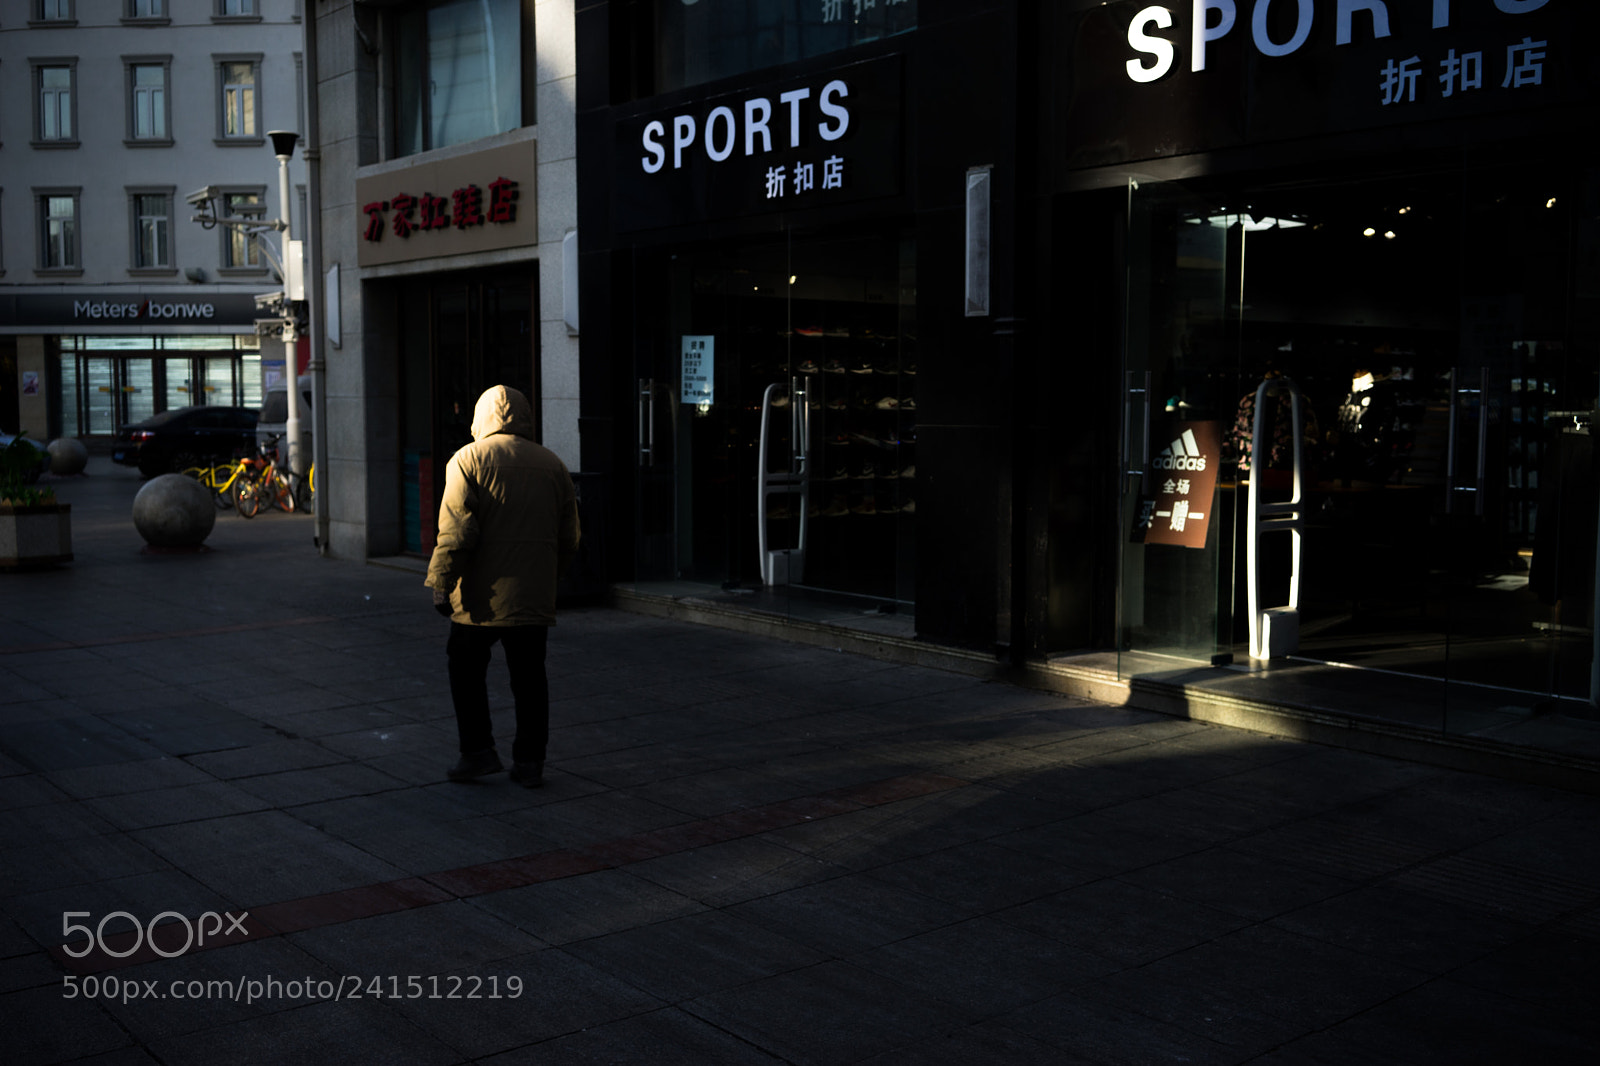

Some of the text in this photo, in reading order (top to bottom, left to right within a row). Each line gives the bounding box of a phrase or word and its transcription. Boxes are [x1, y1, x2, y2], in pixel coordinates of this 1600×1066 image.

[1126, 0, 1549, 84] SPOR
[1379, 38, 1548, 106] 折扣店
[642, 80, 850, 175] SPORTS
[764, 156, 844, 199] 折扣店
[1152, 455, 1206, 472] adidas
[1162, 478, 1190, 495] 全场
